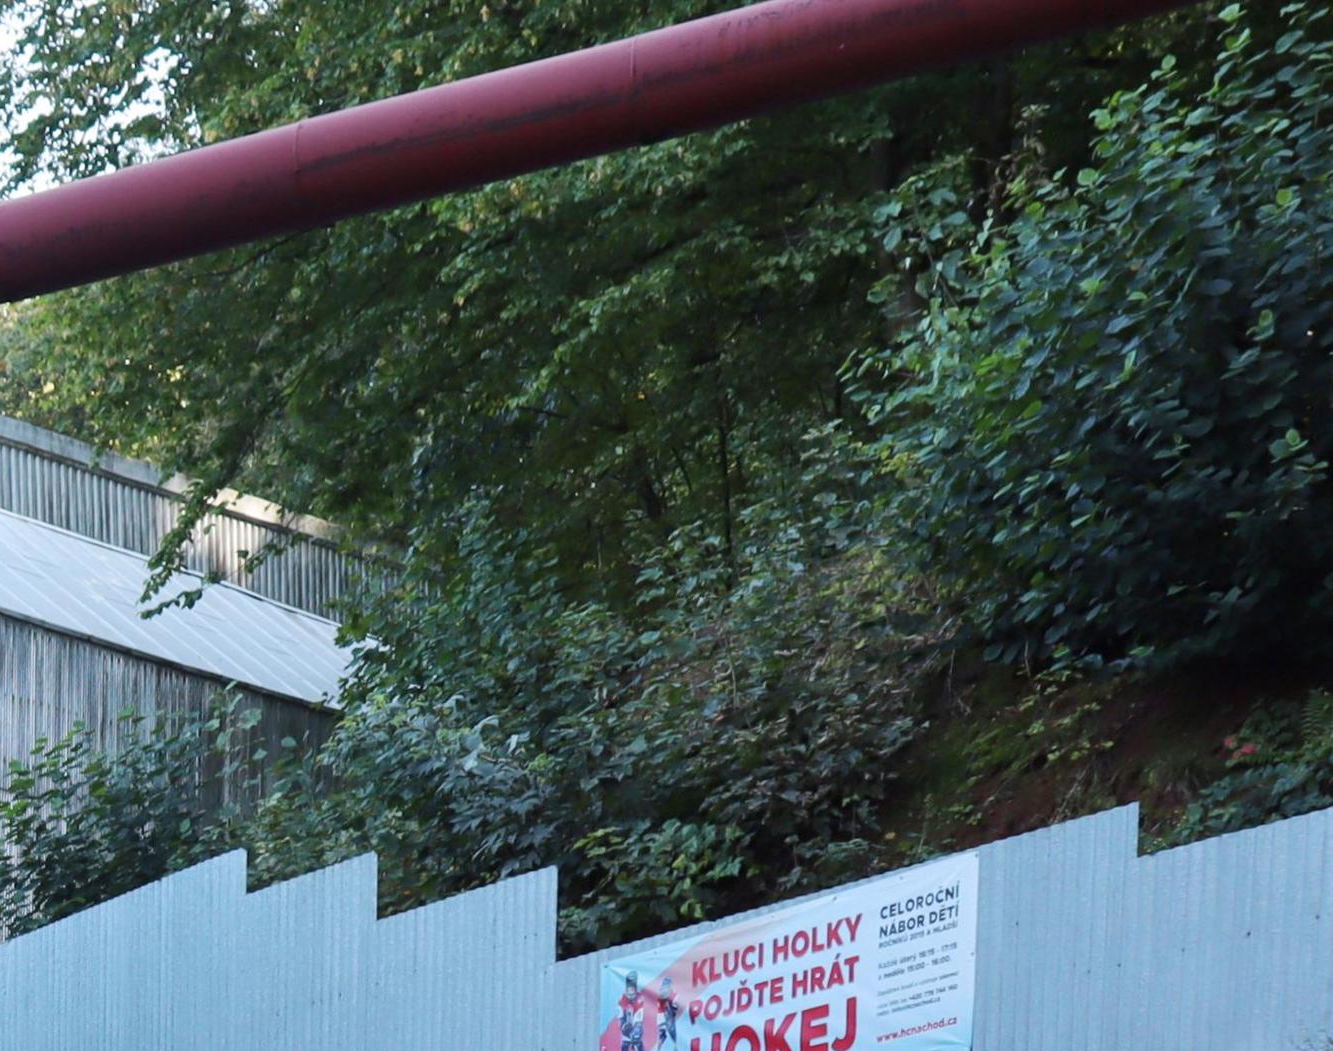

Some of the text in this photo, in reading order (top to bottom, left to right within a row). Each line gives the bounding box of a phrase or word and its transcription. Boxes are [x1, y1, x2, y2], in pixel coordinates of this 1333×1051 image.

[878, 899, 959, 939] NÁBOR DĚTÍ
[879, 880, 960, 920] CELOROČNÍ
[692, 913, 863, 988] KLUCI HOLKY
[688, 976, 785, 1026] POJĎTE
[791, 953, 860, 999] HRÁT
[875, 1016, 958, 1043] www.hcnachod.cz
